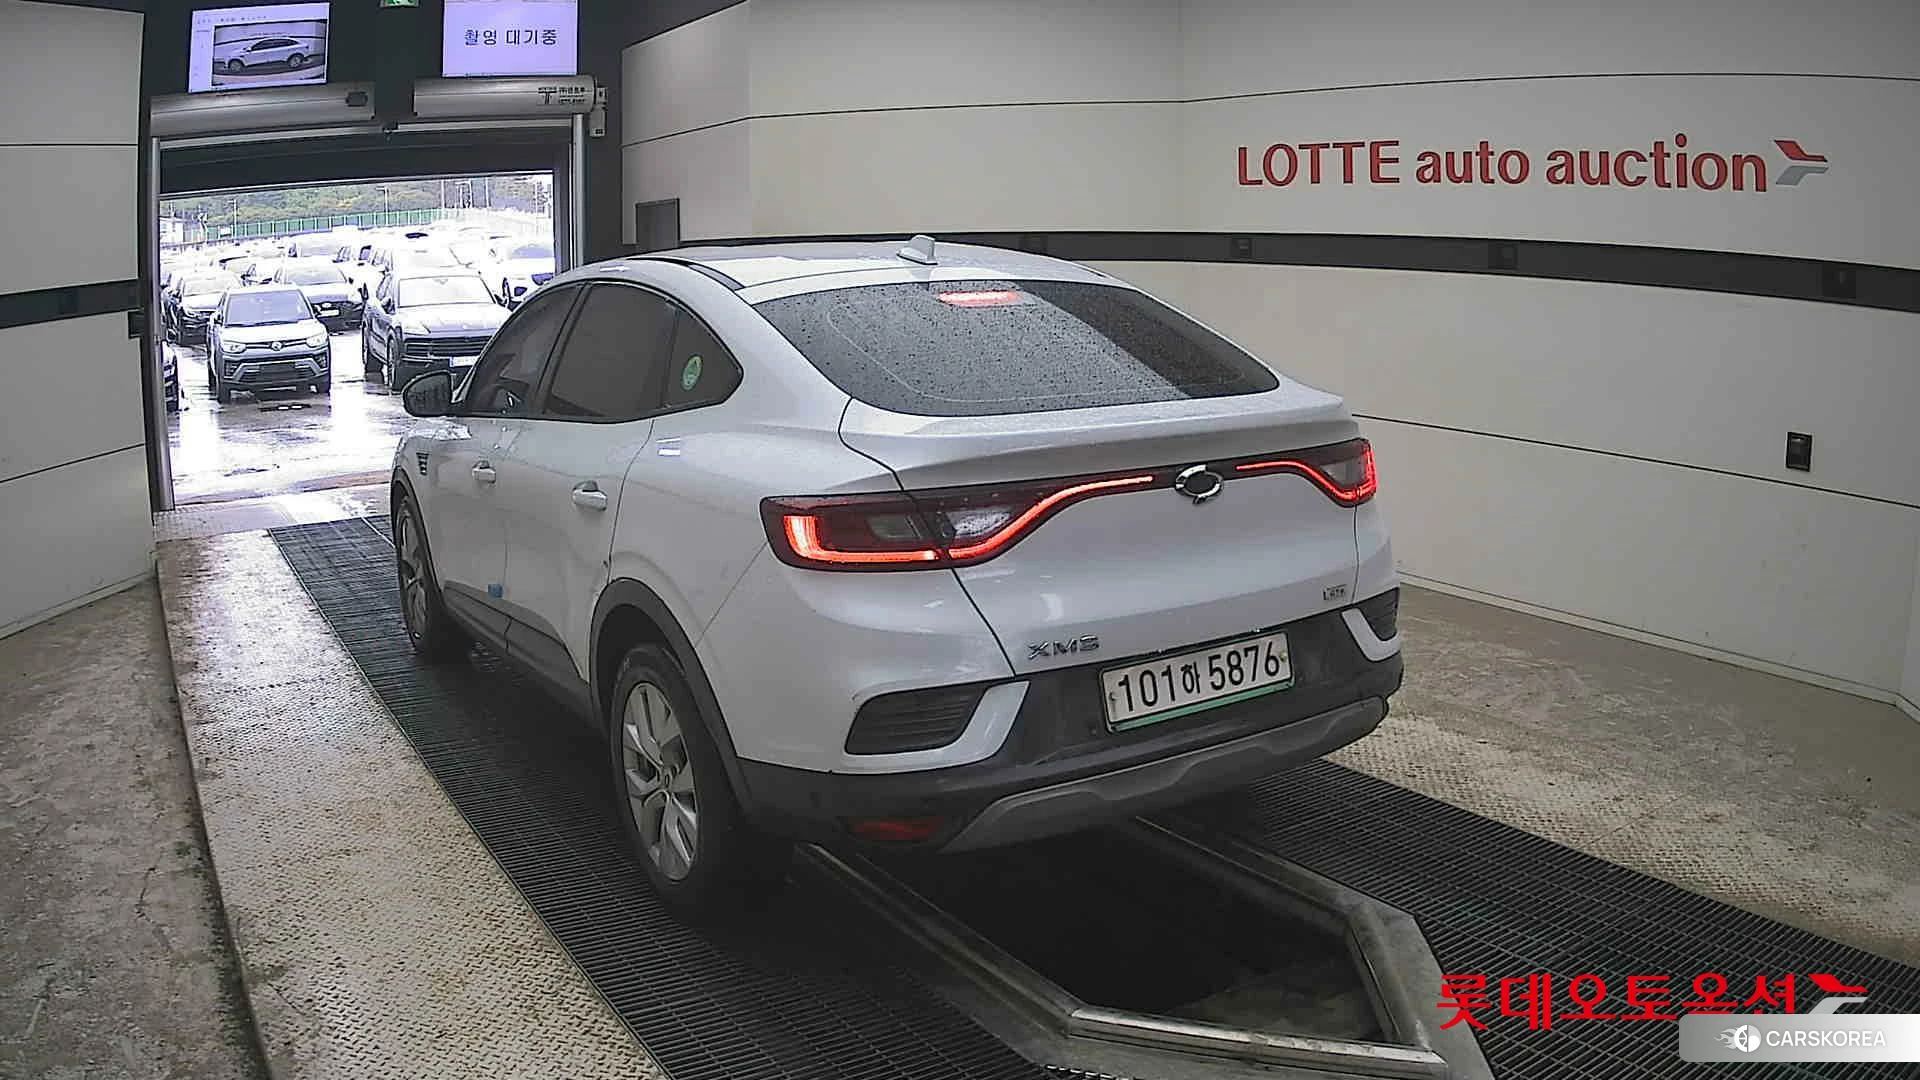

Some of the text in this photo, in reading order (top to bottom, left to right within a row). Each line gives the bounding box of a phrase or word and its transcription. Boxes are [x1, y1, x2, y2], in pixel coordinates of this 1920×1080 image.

[464, 29, 557, 46] 촬영 대기중
[1237, 133, 1767, 192] LOTTE auto auction
[1028, 634, 1099, 659] XM3
[1208, 641, 1280, 691] 5876
